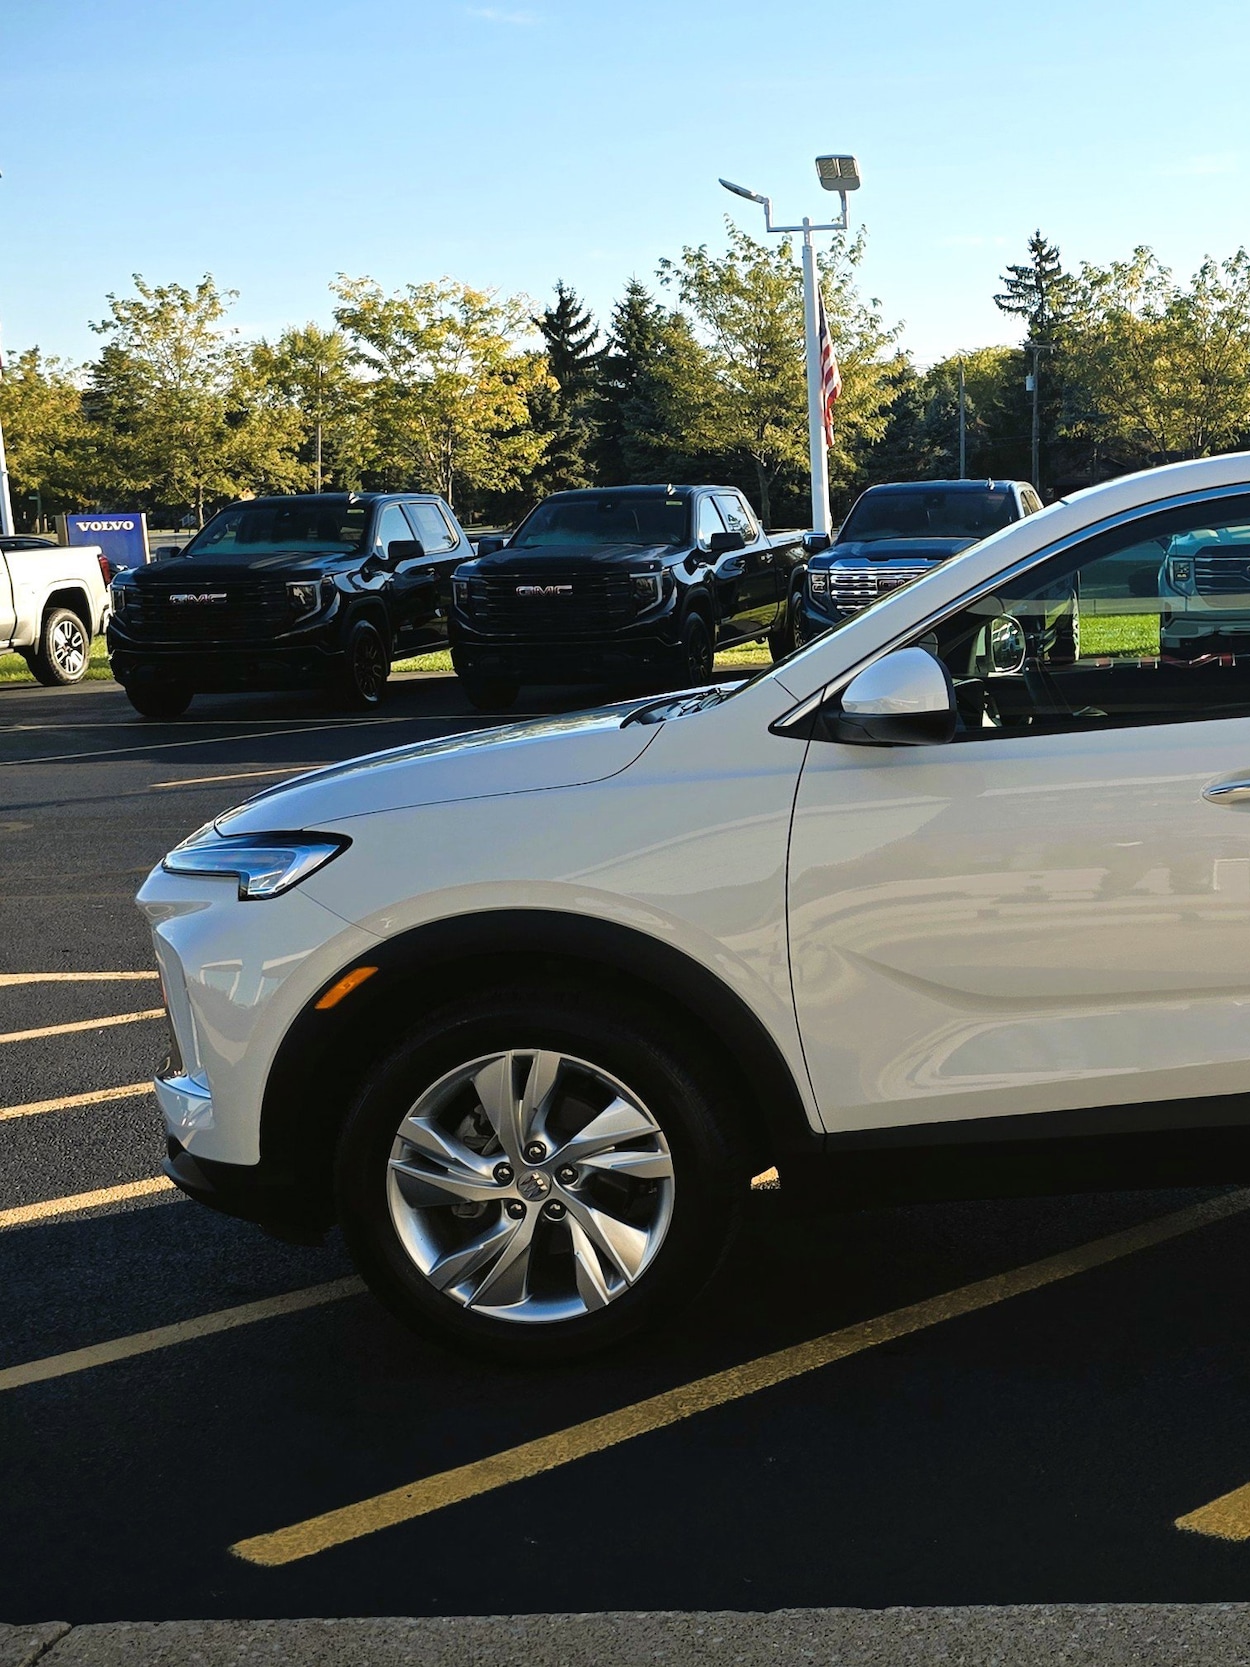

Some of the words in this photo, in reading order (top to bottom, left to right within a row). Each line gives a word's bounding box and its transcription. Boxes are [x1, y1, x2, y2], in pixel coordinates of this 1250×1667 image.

[76, 521, 134, 532] VOLVO
[515, 585, 573, 597] GMC
[169, 593, 227, 605] GMC
